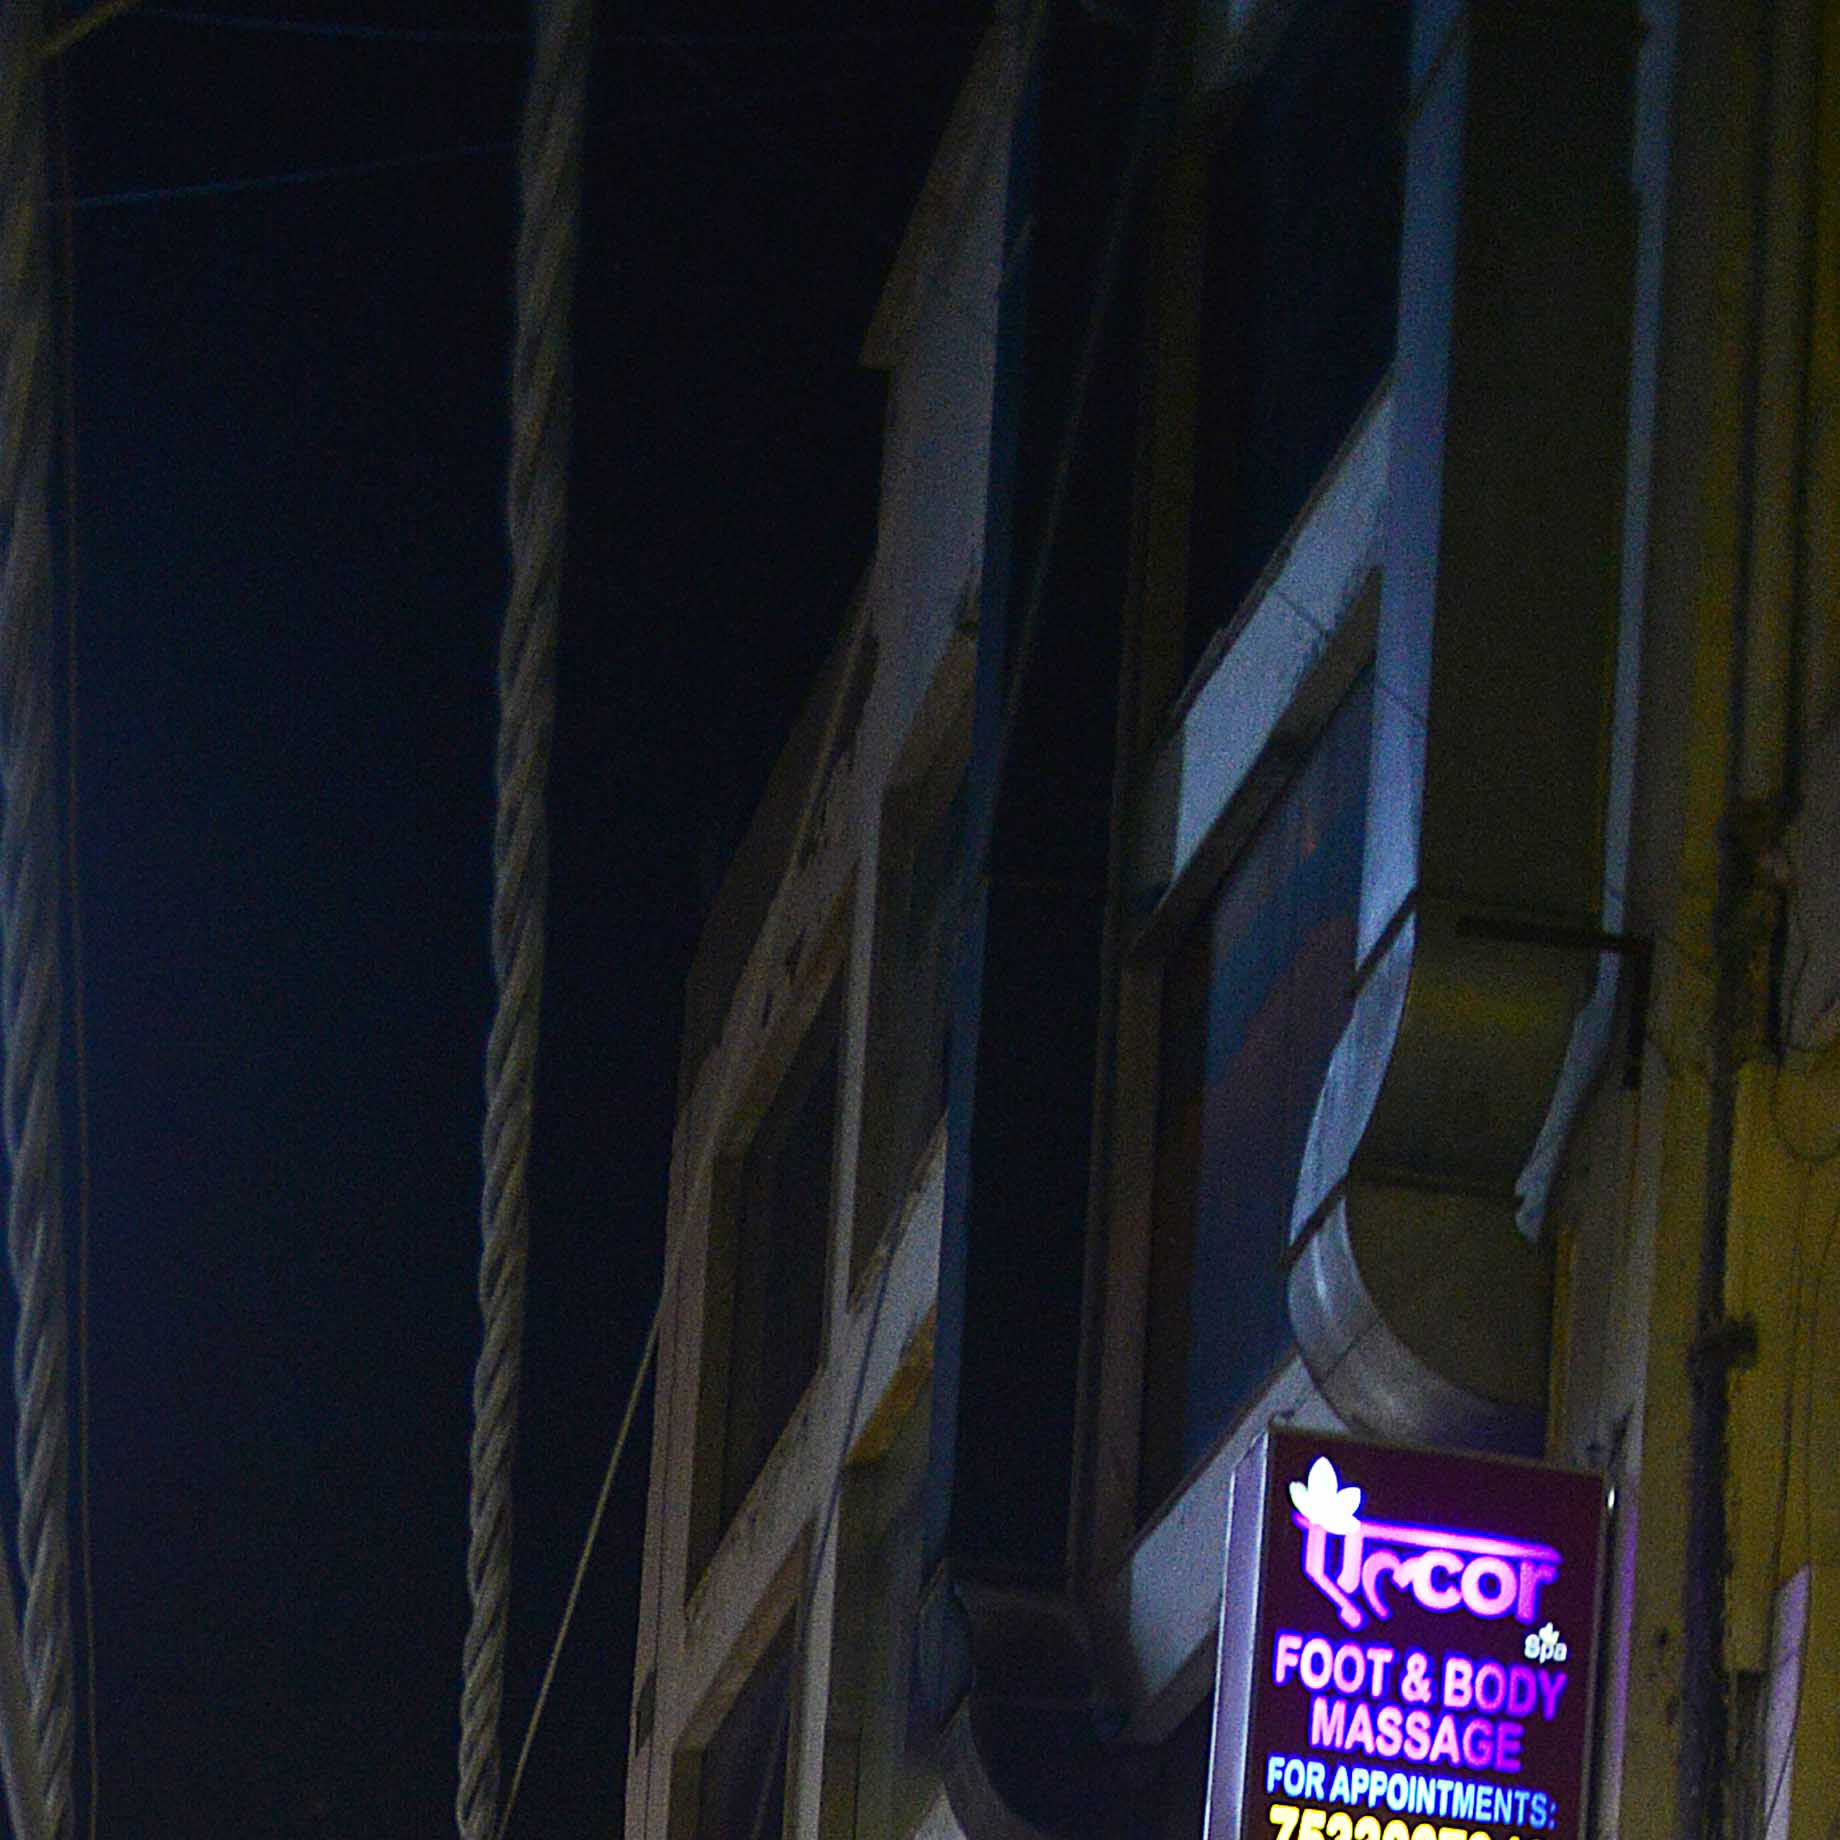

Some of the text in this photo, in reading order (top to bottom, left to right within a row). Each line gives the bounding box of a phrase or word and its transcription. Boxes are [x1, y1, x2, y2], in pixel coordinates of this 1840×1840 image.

[1276, 1634, 1566, 1719] FOOT & BODY
[1311, 1696, 1523, 1772] MASSAGE
[1267, 1757, 1556, 1829] FOR APPOINTMENTS:
